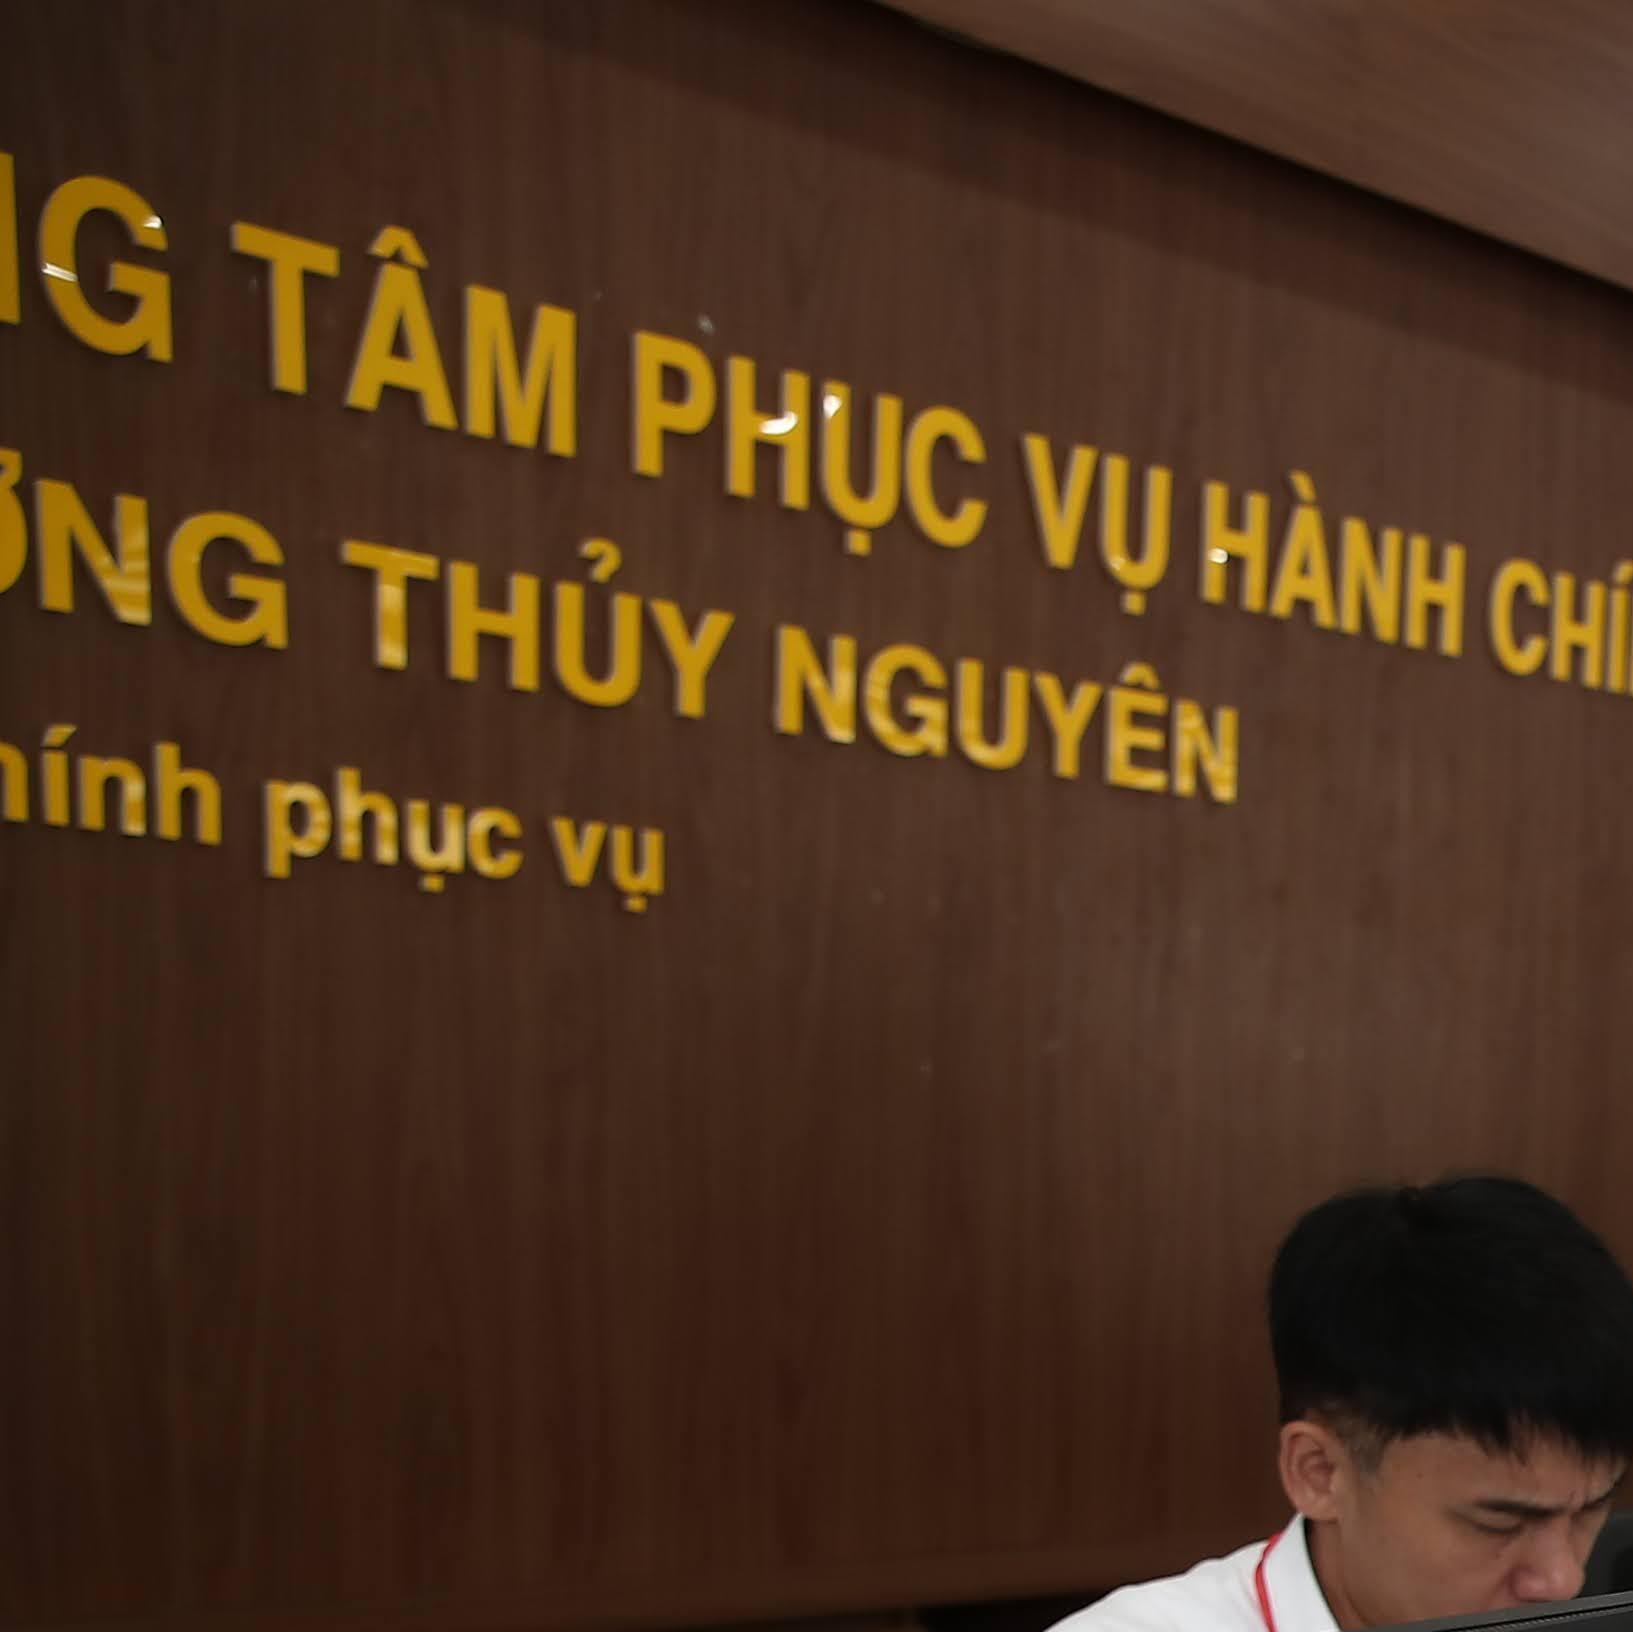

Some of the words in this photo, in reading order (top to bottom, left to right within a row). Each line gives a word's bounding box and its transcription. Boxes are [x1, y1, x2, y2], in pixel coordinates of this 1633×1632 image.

[0, 153, 173, 361] G
[232, 225, 577, 457] TÂM
[633, 330, 988, 555] PHỤC
[1023, 433, 1172, 614] VỤ
[1201, 472, 1465, 657] HÀNH
[341, 539, 734, 719] THỦY
[775, 625, 1238, 803] NGUYÊN
[265, 768, 522, 891] phục
[552, 817, 664, 913] vụ
